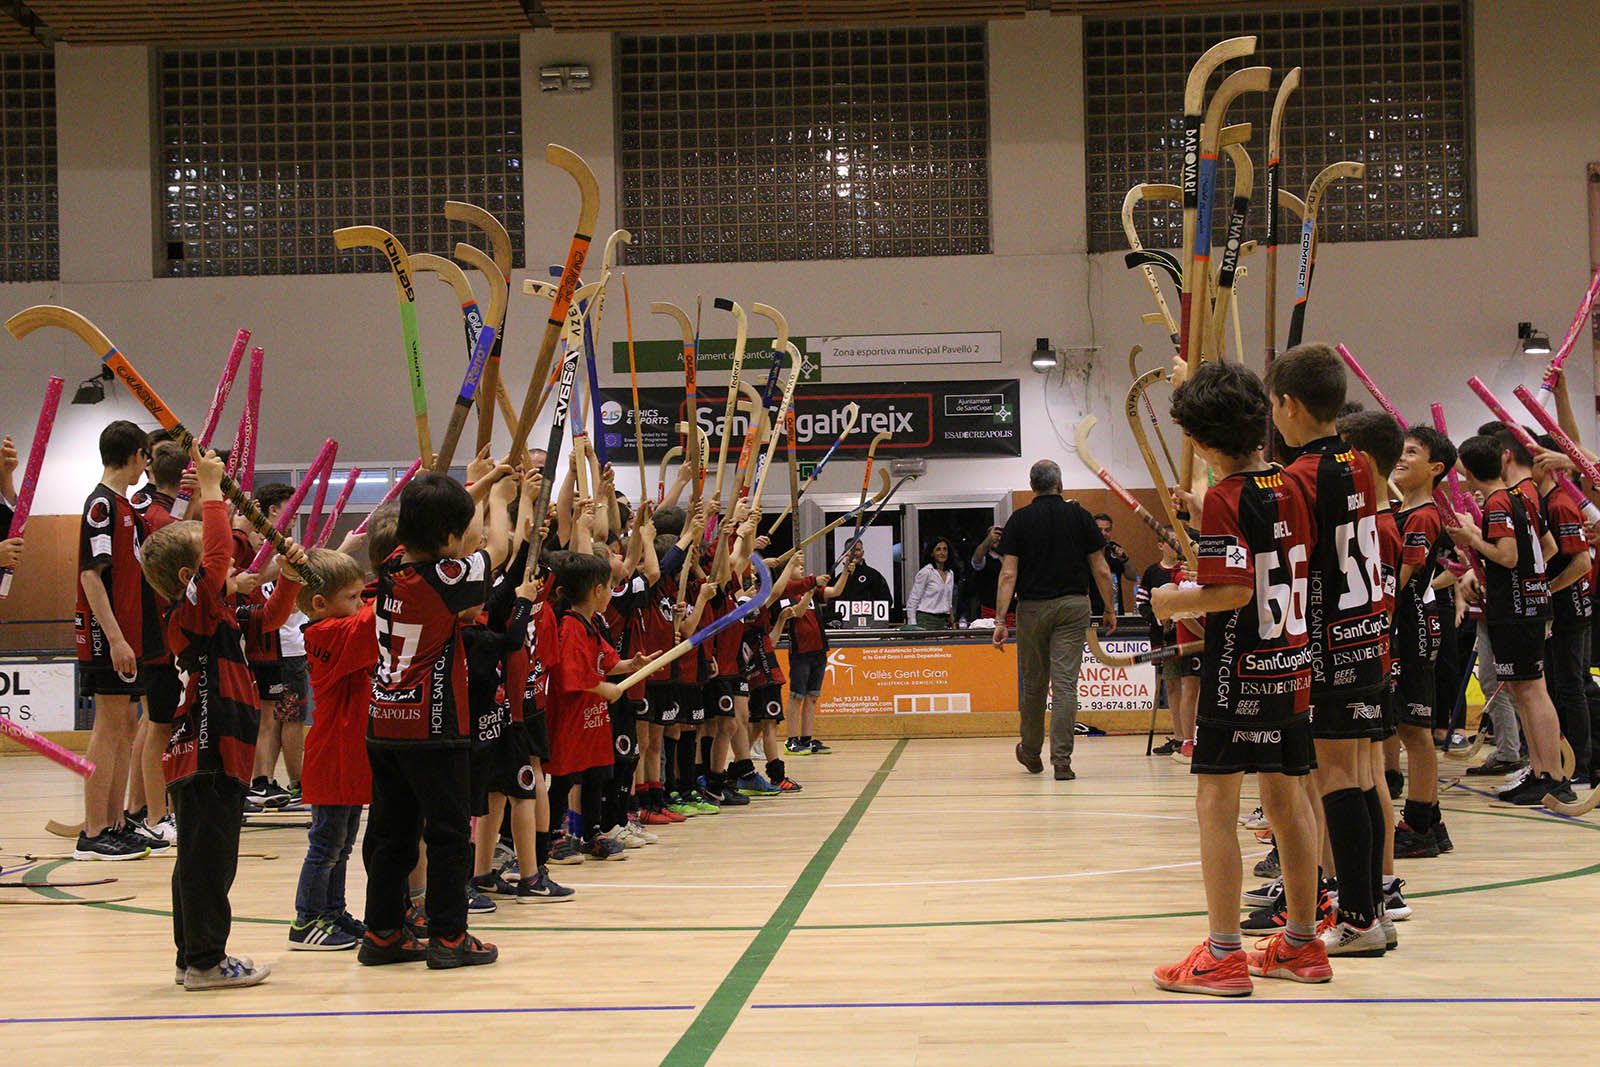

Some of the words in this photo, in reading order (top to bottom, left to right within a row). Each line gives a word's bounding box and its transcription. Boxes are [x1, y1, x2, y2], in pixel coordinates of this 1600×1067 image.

[1185, 128, 1198, 194] BAROVARI
[1221, 213, 1246, 273] BAROVARI
[1298, 232, 1311, 287] COMPACT
[677, 352, 726, 360] Atament
[832, 348, 855, 357] Zona
[856, 346, 896, 358] esportiva
[898, 345, 941, 357] municipal
[942, 344, 973, 355] Pavelló
[974, 345, 980, 354] 2
[730, 360, 741, 390] federal
[634, 416, 670, 425] PORTS
[695, 405, 915, 443] SangatCreix
[944, 430, 1014, 439] ESADECREAPOLIS
[1273, 520, 1293, 540] BIEL
[1335, 514, 1384, 611] 58
[1254, 543, 1308, 641] 56
[1310, 570, 1323, 606] HOTEL
[382, 594, 404, 614] ÀLEX
[876, 603, 886, 619] 0
[1225, 607, 1242, 630] TEL
[1311, 609, 1324, 640] SANT
[92, 628, 102, 656] HOTEL
[1105, 642, 1149, 653] CLINIC
[1220, 631, 1237, 665] SANT
[862, 669, 892, 680] Vallès
[894, 668, 920, 679] Gent
[922, 668, 949, 679] Gran
[1310, 641, 1327, 683] CUGAT
[432, 671, 446, 700] SANT
[1077, 682, 1149, 697] SCÈNCIA
[1216, 667, 1231, 710] CUGAT
[368, 703, 421, 720] EAPOLIS
[1091, 701, 1153, 710] 93-674.81.70
[1238, 699, 1260, 708] GEFF
[432, 700, 443, 734] HOTEL
[1232, 729, 1282, 744] Reno
